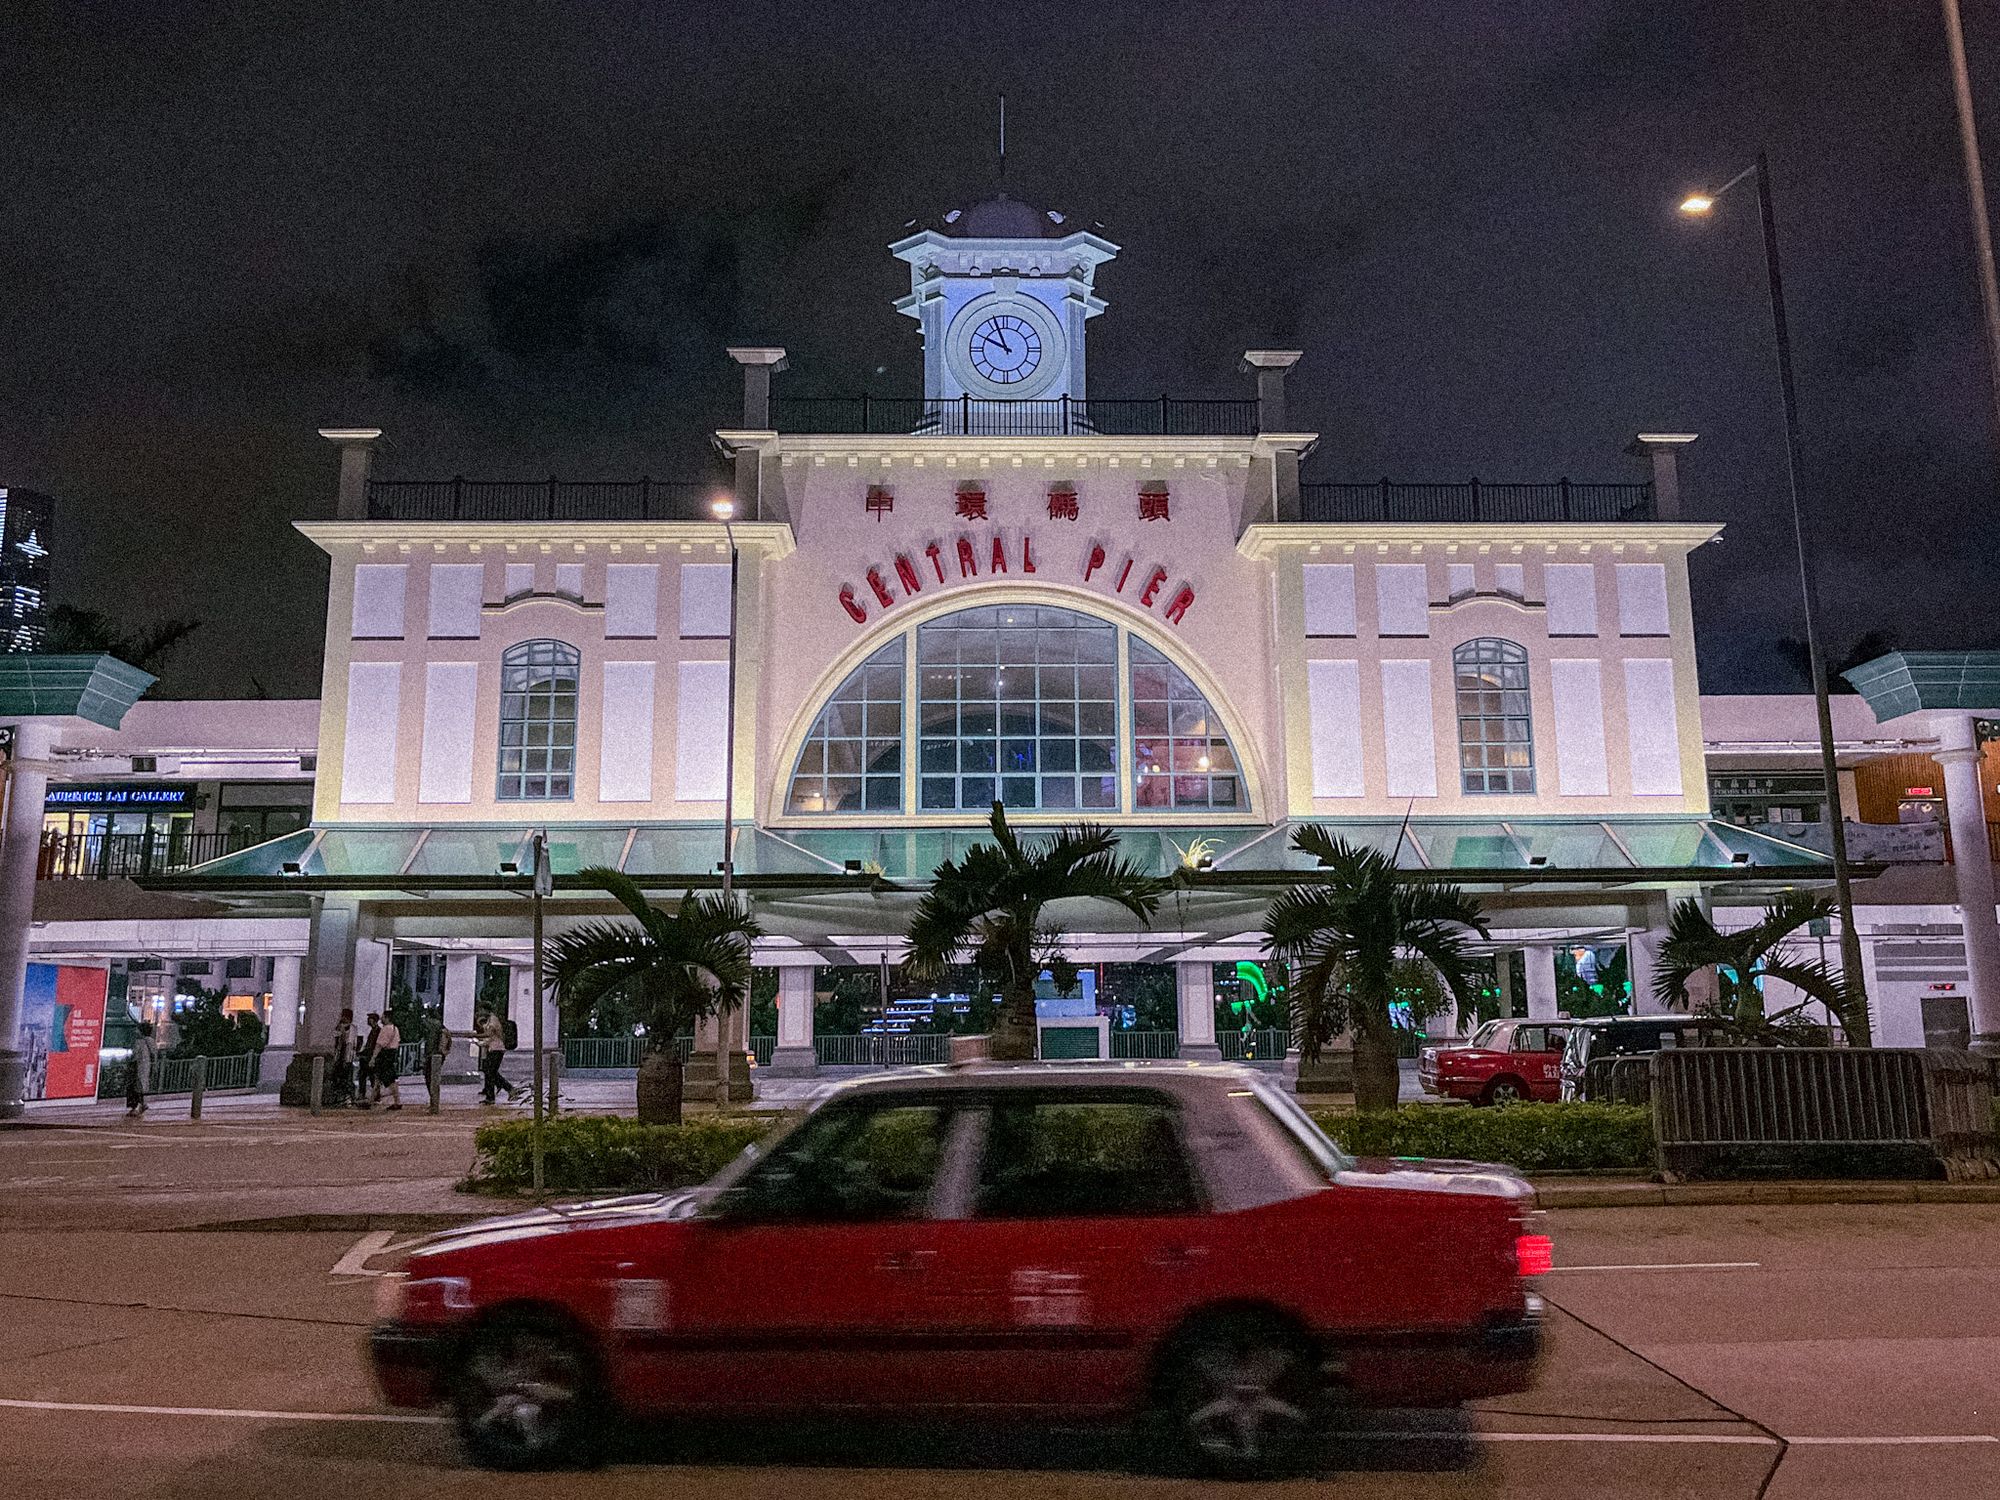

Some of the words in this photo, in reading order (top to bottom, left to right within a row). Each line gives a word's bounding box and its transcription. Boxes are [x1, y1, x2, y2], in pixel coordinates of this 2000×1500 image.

[866, 491, 1170, 522] 中環碼頭
[839, 537, 1036, 623] CENTRAL
[1084, 544, 1195, 625] PIER
[106, 791, 127, 802] LAI
[131, 791, 185, 802] GALLERY
